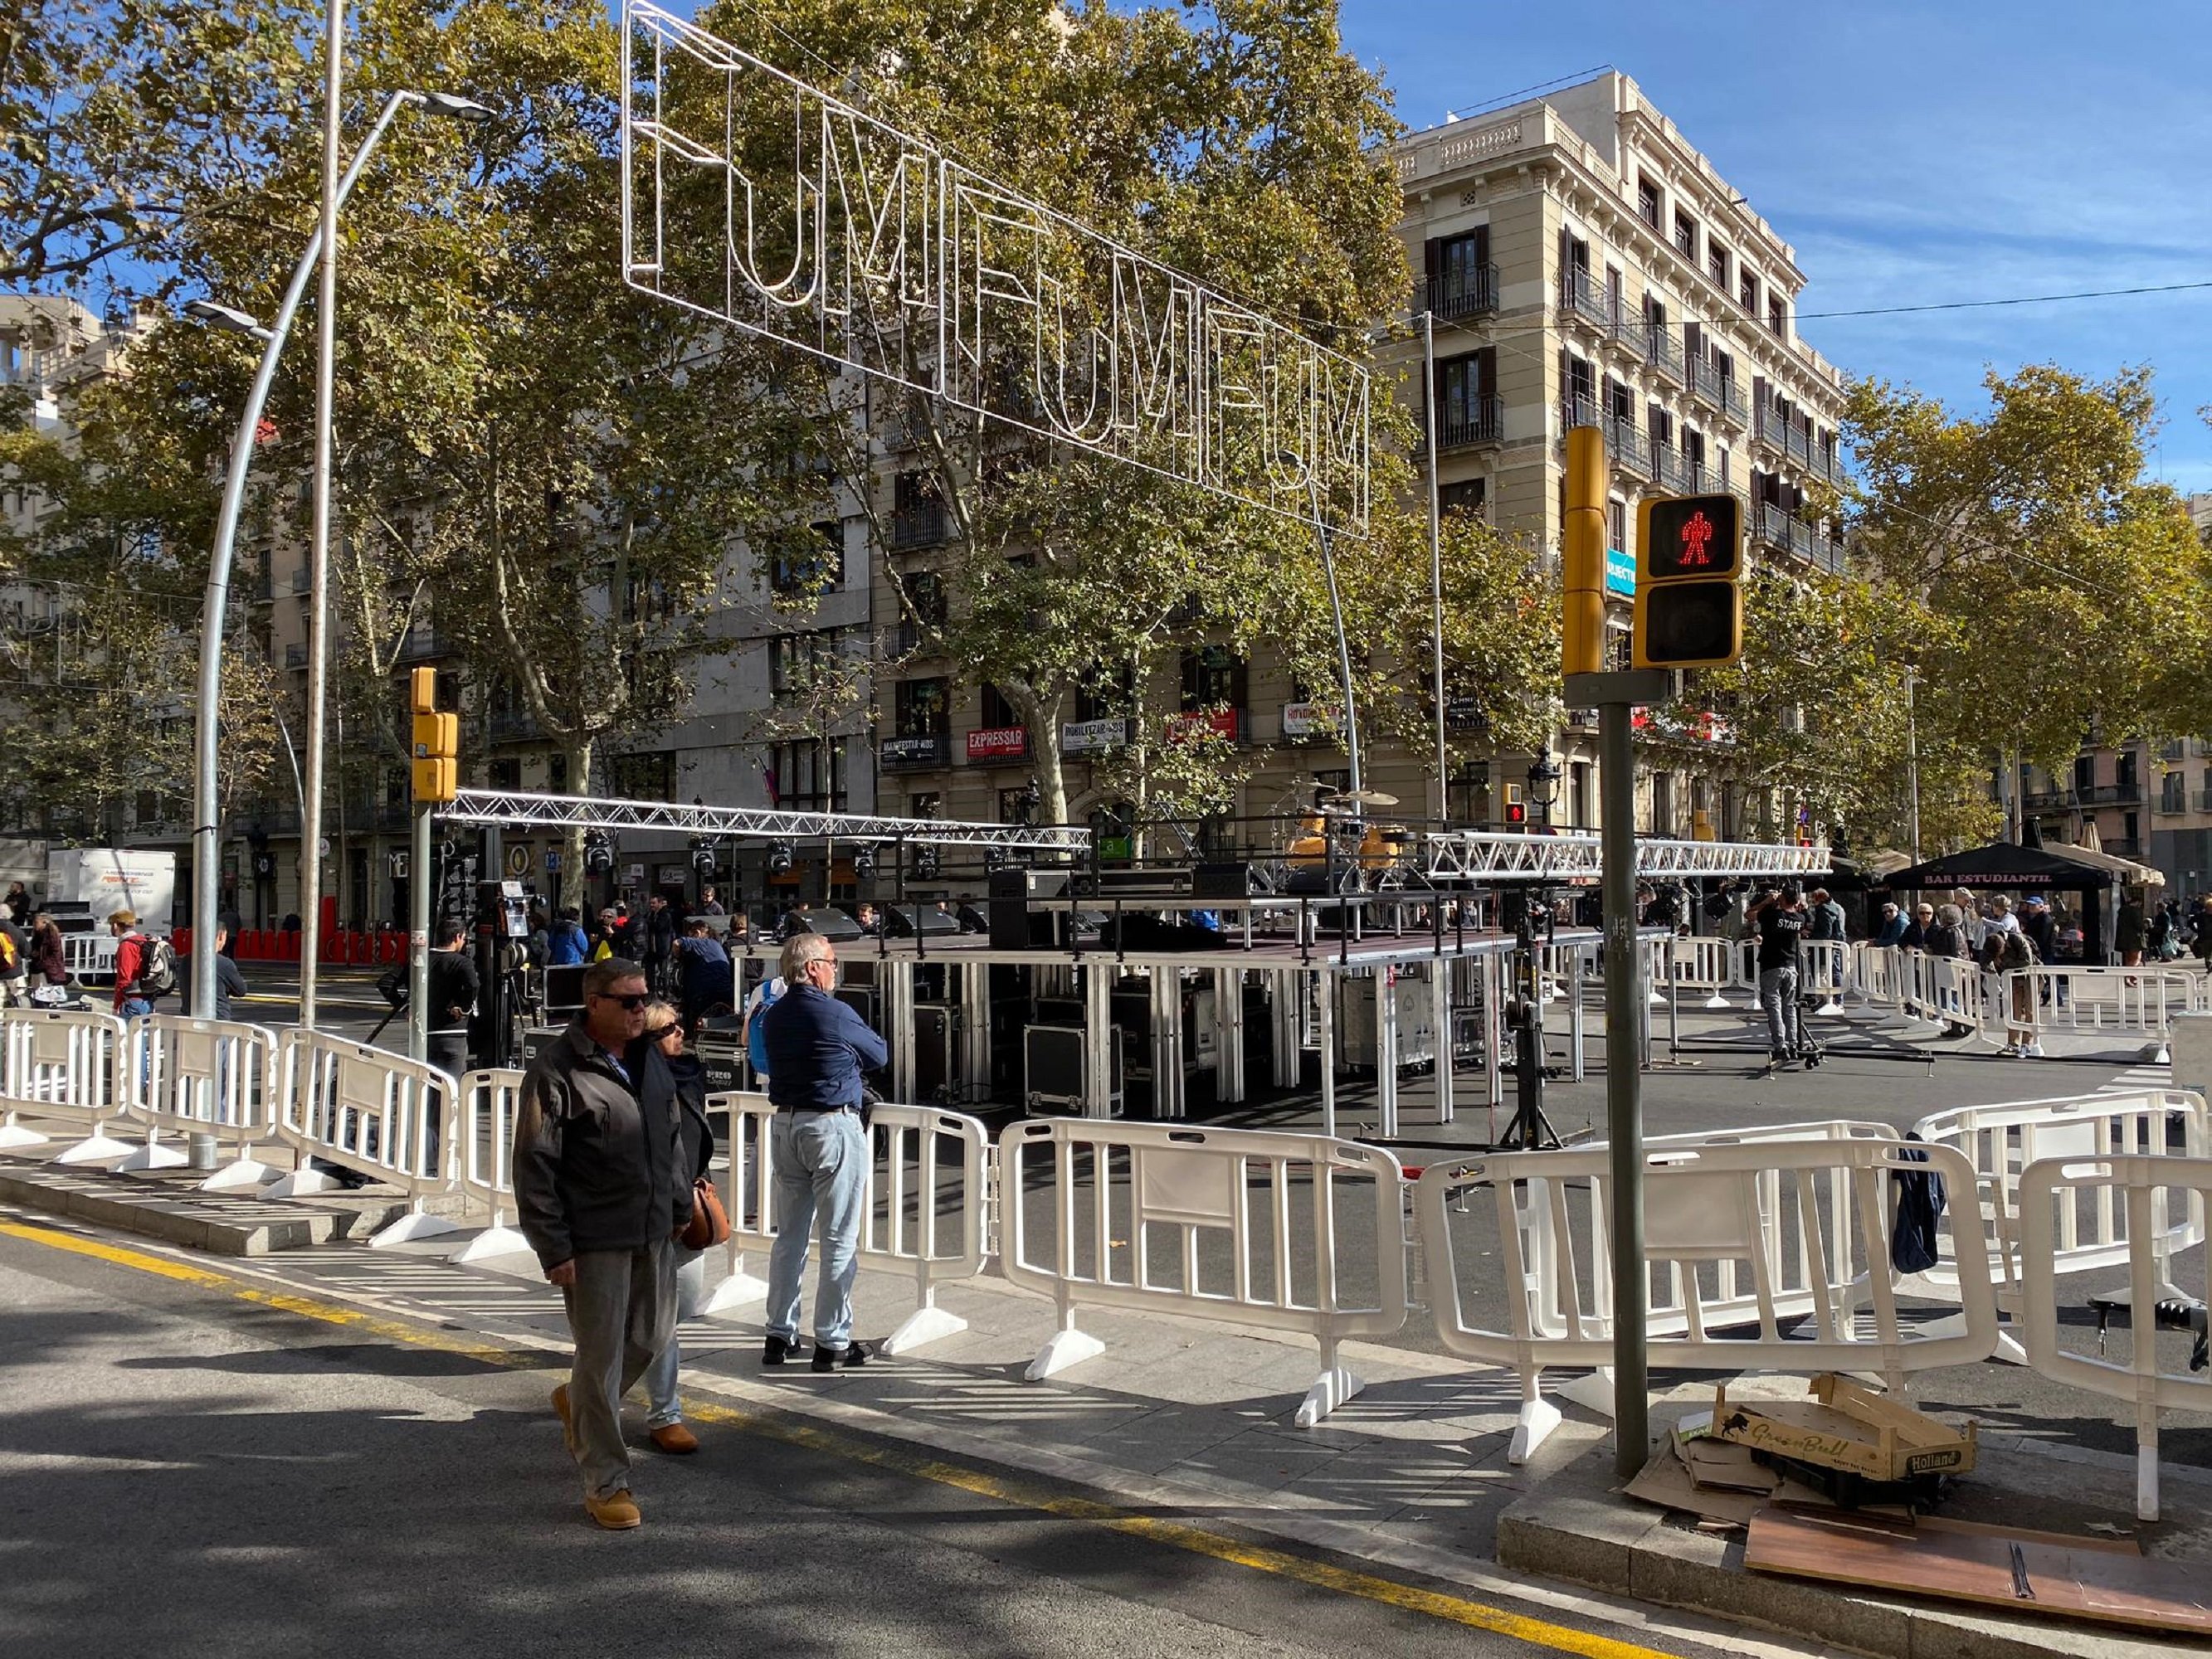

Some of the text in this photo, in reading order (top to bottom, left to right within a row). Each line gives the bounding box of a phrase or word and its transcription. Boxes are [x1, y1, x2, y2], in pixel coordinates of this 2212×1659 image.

[969, 730, 1022, 747] EXPRESSAR
[1925, 873, 2052, 883] BAR ESTUDIANTIL
[1777, 918, 1803, 931] STAFF
[1912, 1454, 1955, 1471] Holland
